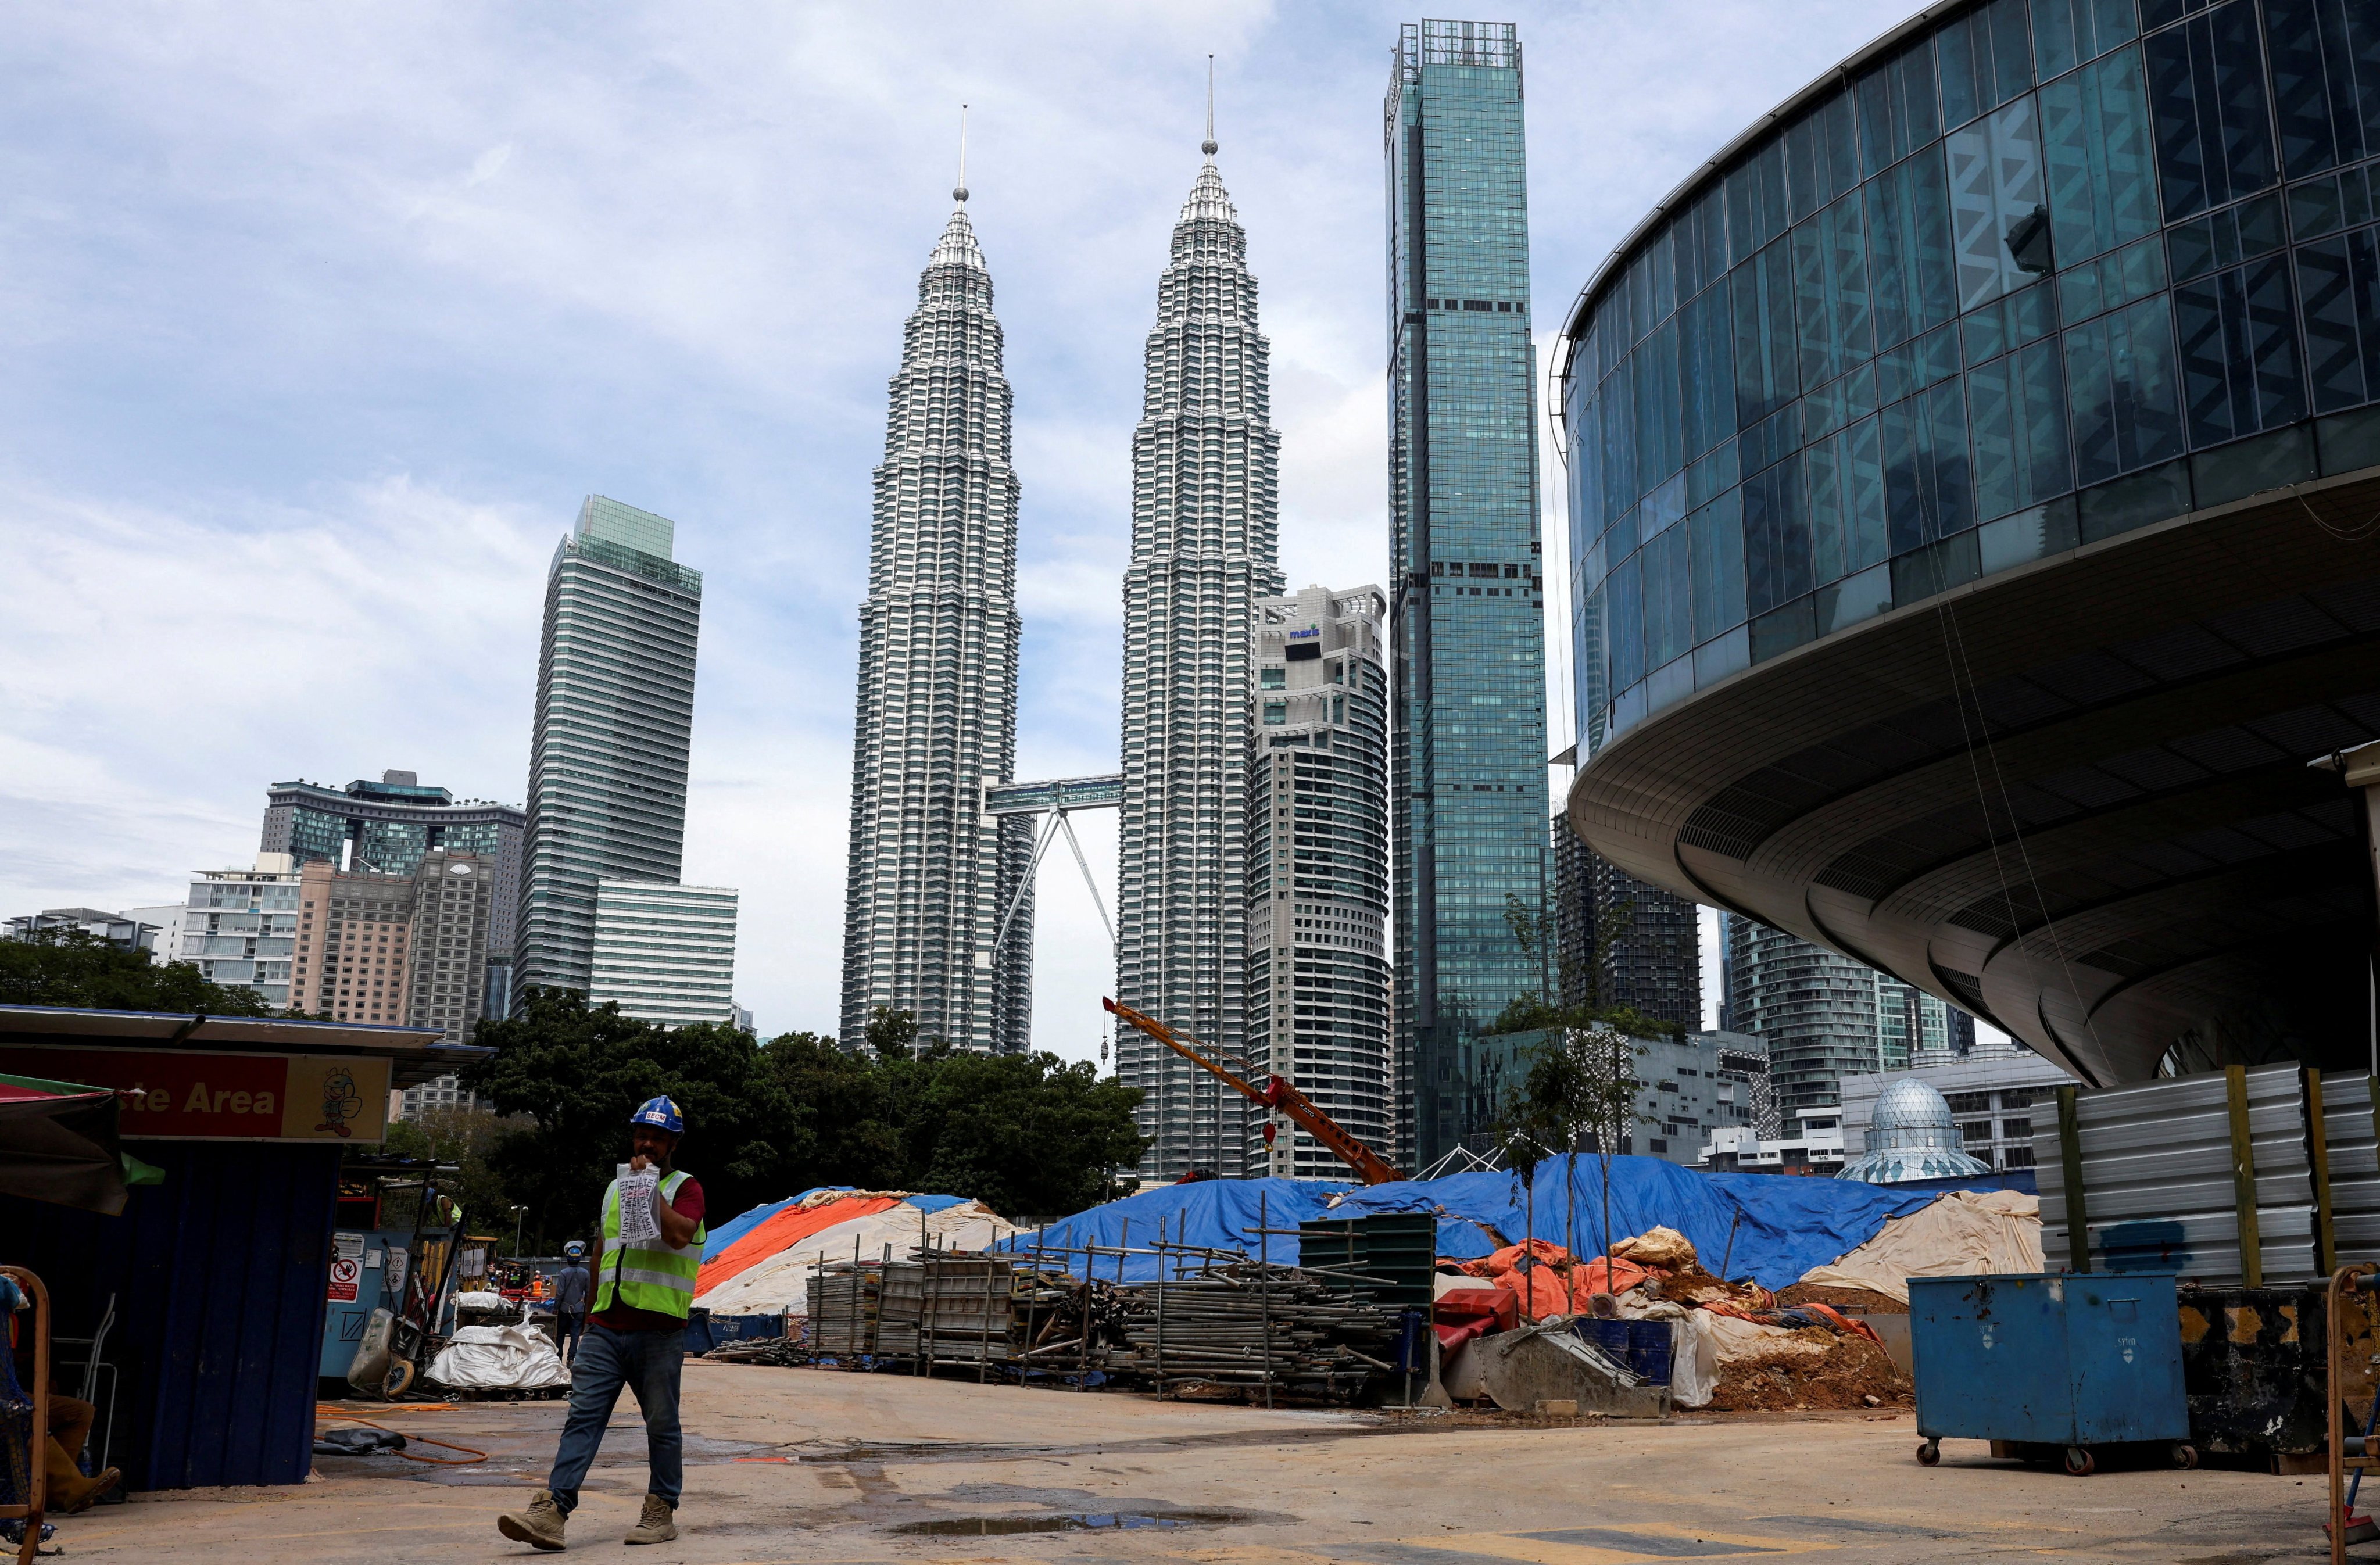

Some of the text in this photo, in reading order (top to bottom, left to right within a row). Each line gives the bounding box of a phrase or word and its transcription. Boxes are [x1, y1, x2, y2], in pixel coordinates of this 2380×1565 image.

[1290, 624, 1319, 639] maxis
[182, 1081, 274, 1115] Area
[647, 1113, 666, 1121] SECM
[1299, 1103, 1315, 1118] KATO
